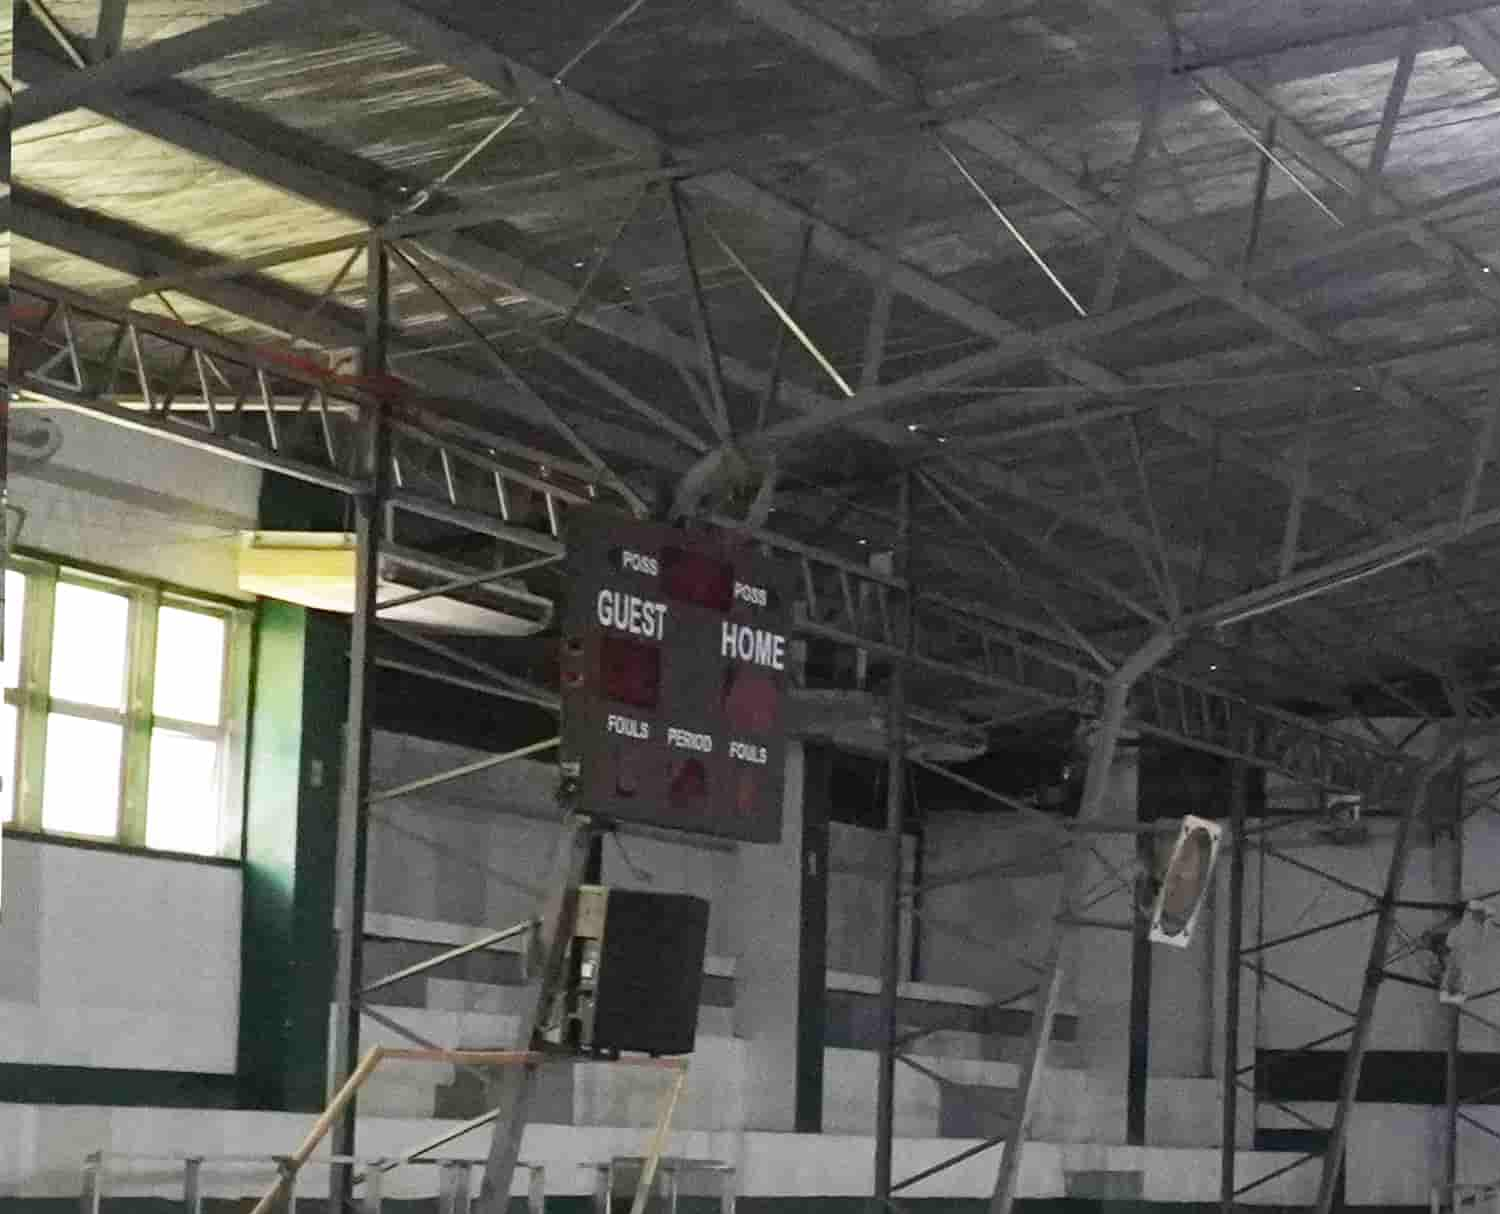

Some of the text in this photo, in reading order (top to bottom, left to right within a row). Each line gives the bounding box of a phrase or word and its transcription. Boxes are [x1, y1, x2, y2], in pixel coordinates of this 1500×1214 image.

[622, 550, 658, 576] POSS
[597, 588, 668, 640] GUEST
[721, 621, 785, 671] HOME
[607, 713, 649, 740] FOULS
[667, 727, 713, 753] PERIOD
[729, 740, 768, 765] FOULS
